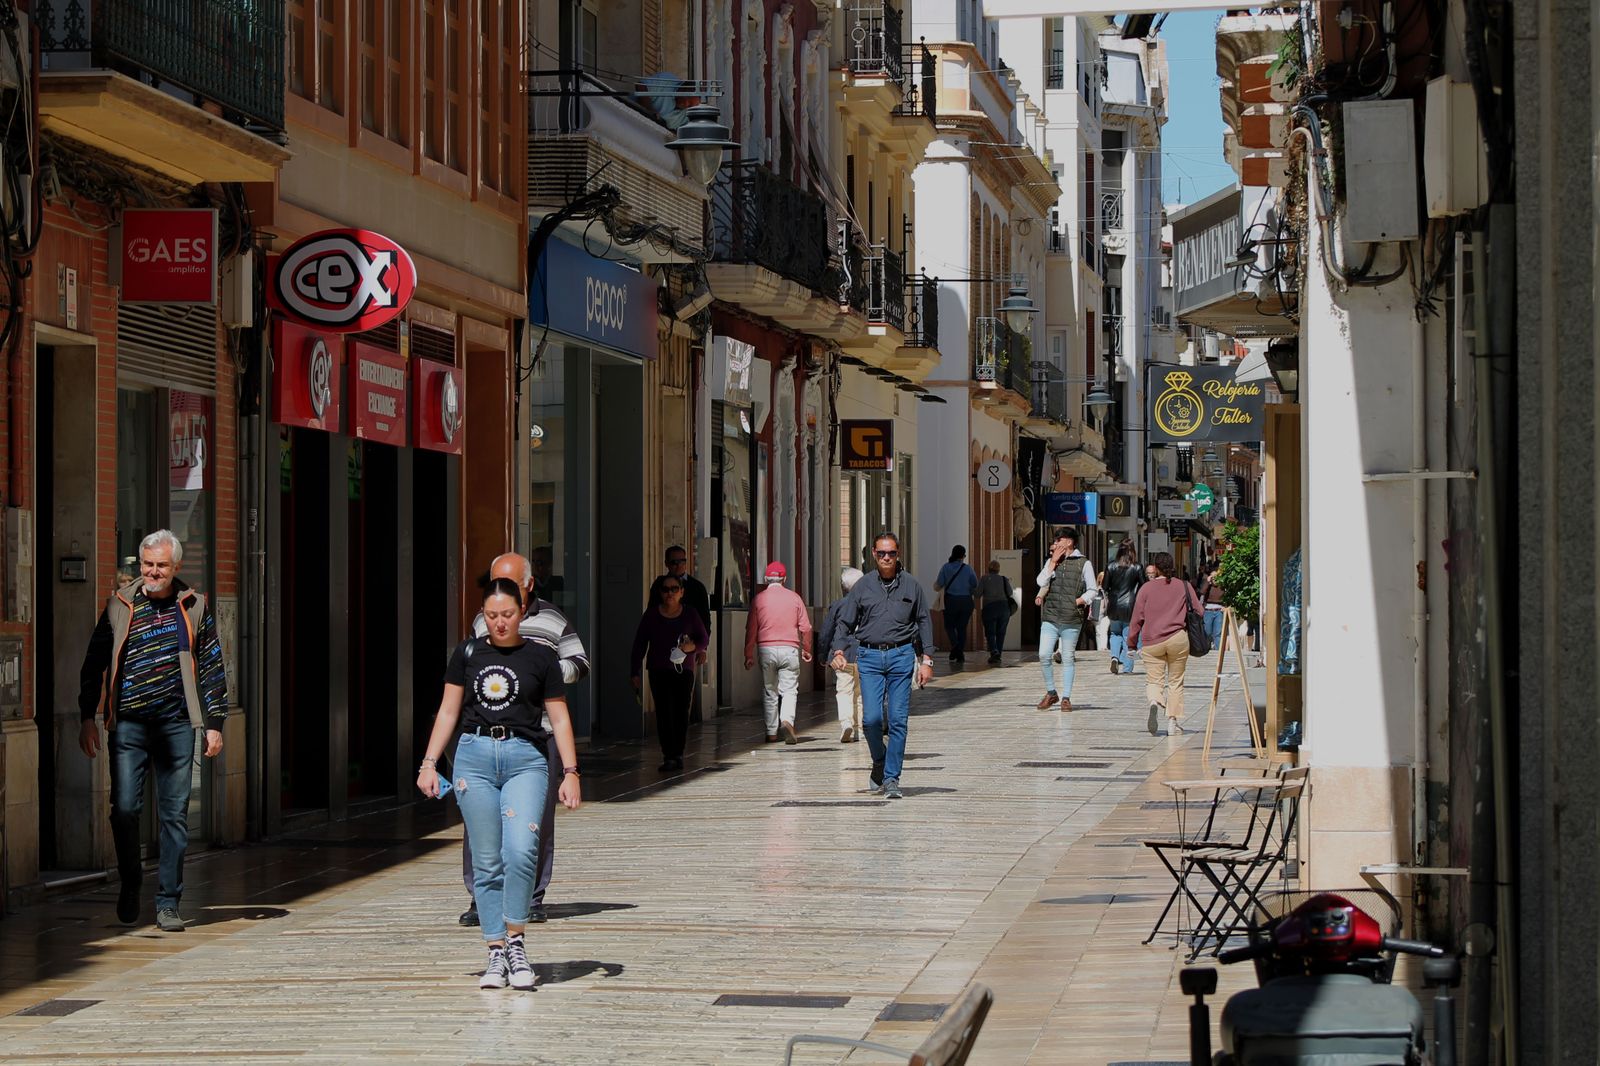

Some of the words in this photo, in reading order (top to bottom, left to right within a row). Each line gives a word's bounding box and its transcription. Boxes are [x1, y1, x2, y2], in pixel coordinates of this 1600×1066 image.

[127, 237, 208, 264] GAES
[1178, 214, 1239, 293] BENAVENTE
[168, 265, 206, 276] amplifon
[359, 358, 404, 391] ENTERTAINMENT
[1202, 379, 1261, 404] Relojería
[368, 391, 397, 418] EXCHANGE
[1211, 407, 1254, 426] Taller
[848, 459, 886, 468] TABACOS
[479, 665, 504, 675] FLOWERS
[505, 667, 517, 679] NEED
